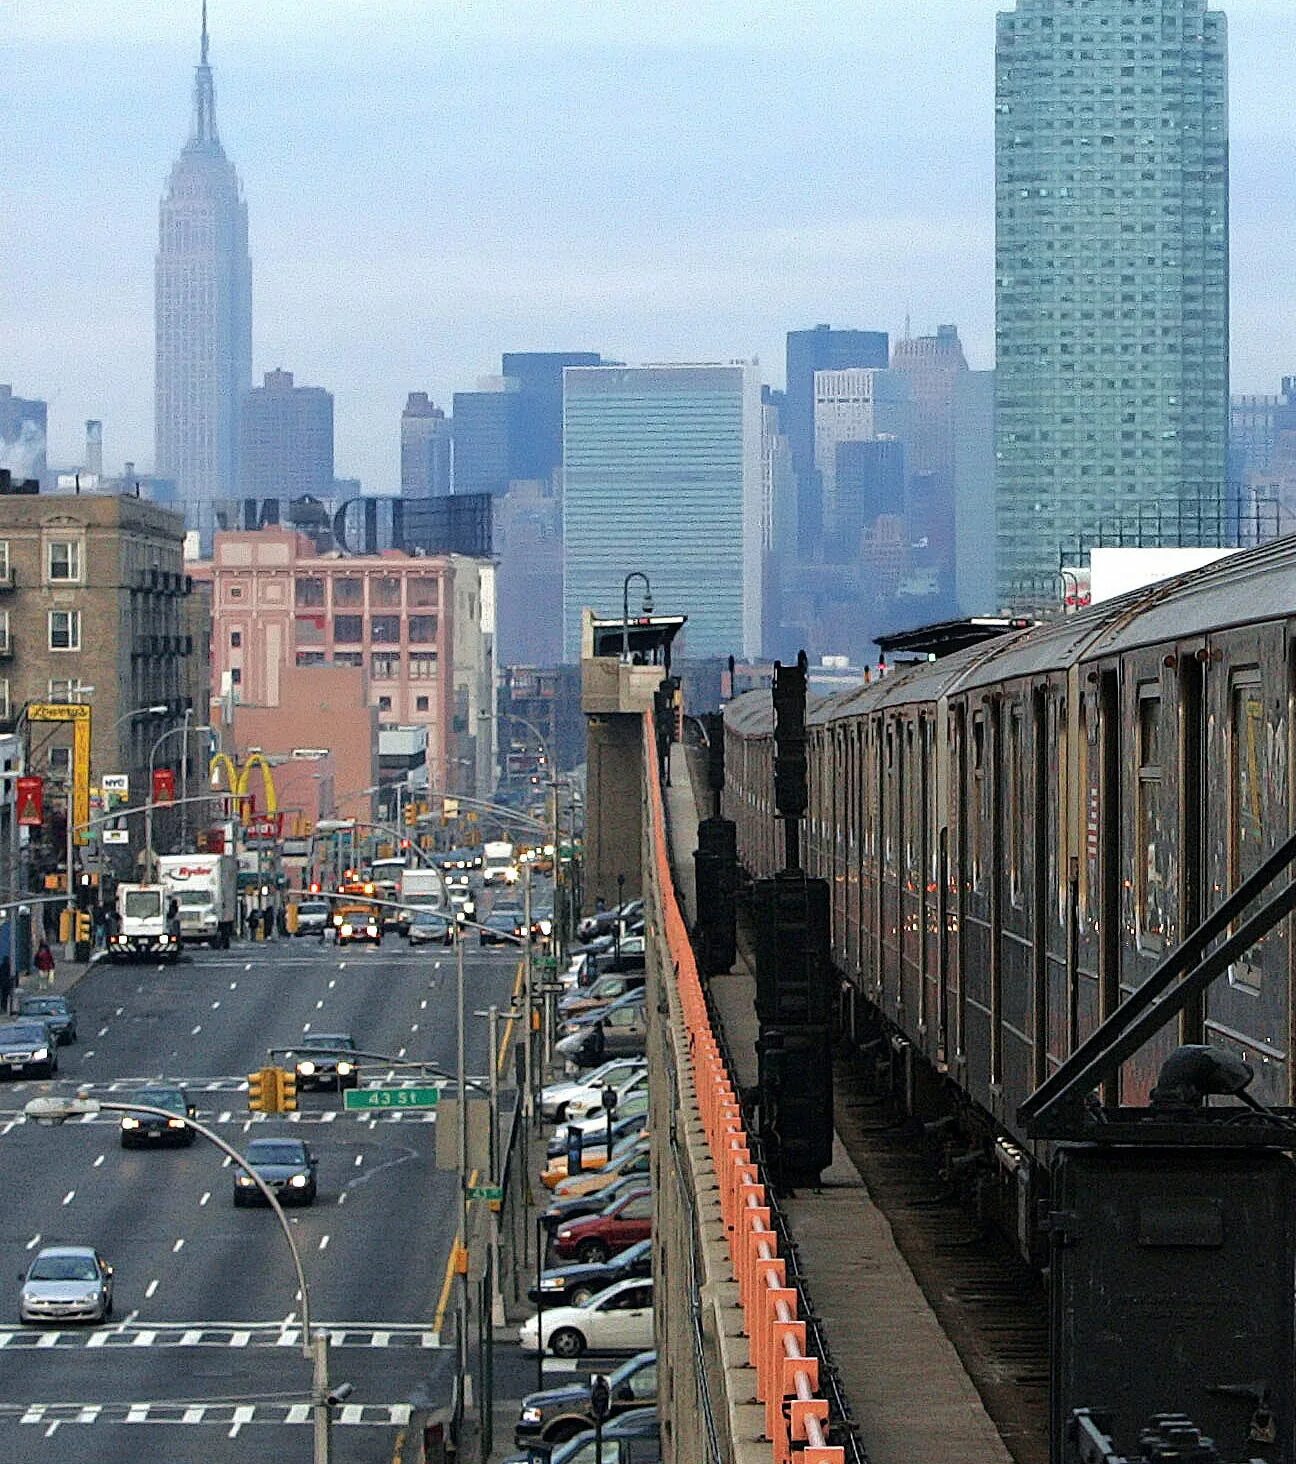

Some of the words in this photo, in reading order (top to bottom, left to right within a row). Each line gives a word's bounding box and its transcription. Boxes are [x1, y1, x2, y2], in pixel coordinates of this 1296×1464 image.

[178, 866, 213, 878] Ryder
[368, 1093, 391, 1105] 43
[397, 1092, 418, 1104] St
